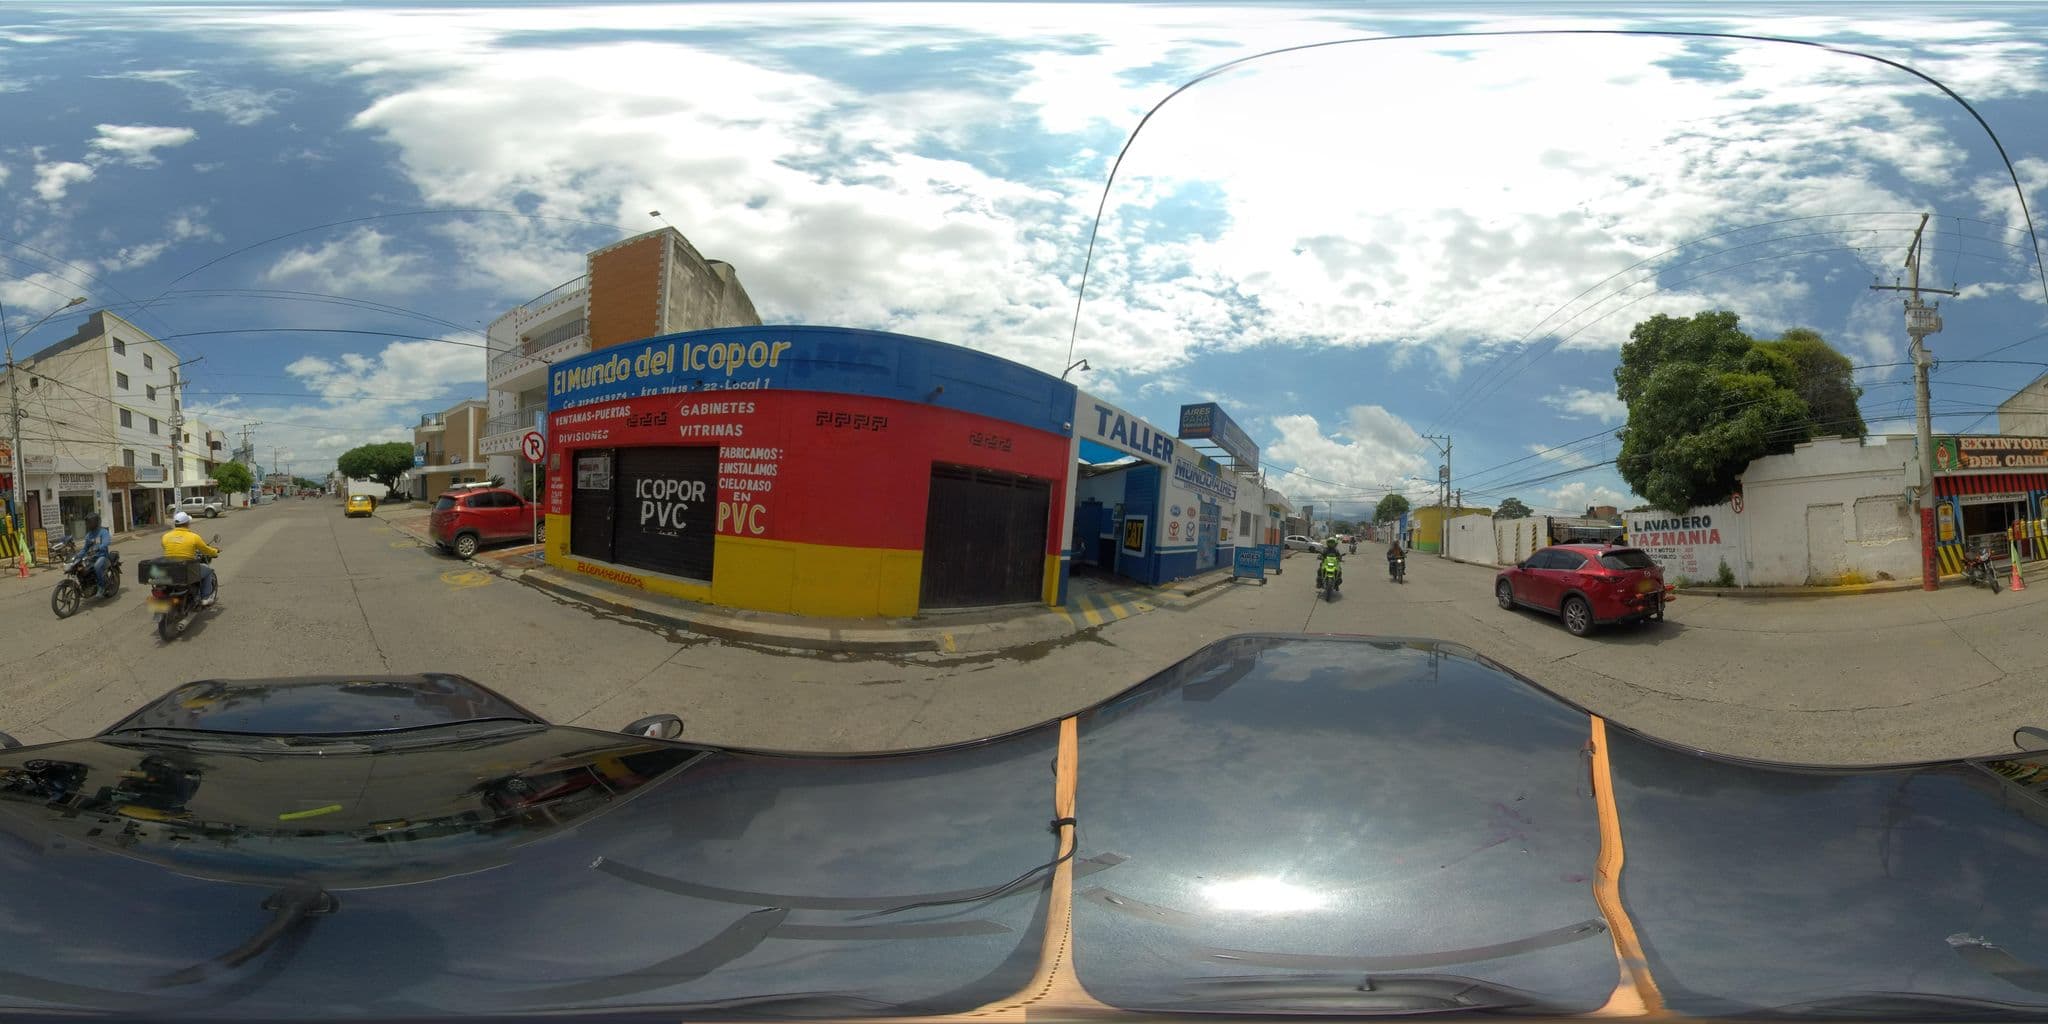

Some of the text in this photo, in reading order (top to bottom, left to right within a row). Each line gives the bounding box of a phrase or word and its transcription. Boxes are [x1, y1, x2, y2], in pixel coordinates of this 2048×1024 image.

[553, 341, 792, 395] El Mundo del Icopor
[725, 378, 760, 391] Local
[680, 402, 755, 417] GABINETES
[559, 430, 609, 443] DIVISIONES
[680, 424, 744, 437] VITRINAS
[1094, 404, 1174, 464] TALLER
[1968, 455, 2001, 468] DEL
[636, 479, 706, 502] ICOPOR
[733, 492, 751, 501] EN
[641, 501, 689, 529] PVC
[717, 502, 767, 534] PVC
[1634, 516, 1712, 532] LAVADERO
[1631, 529, 1721, 546] TAZMANIA
[578, 561, 645, 589] Bienvenidos
